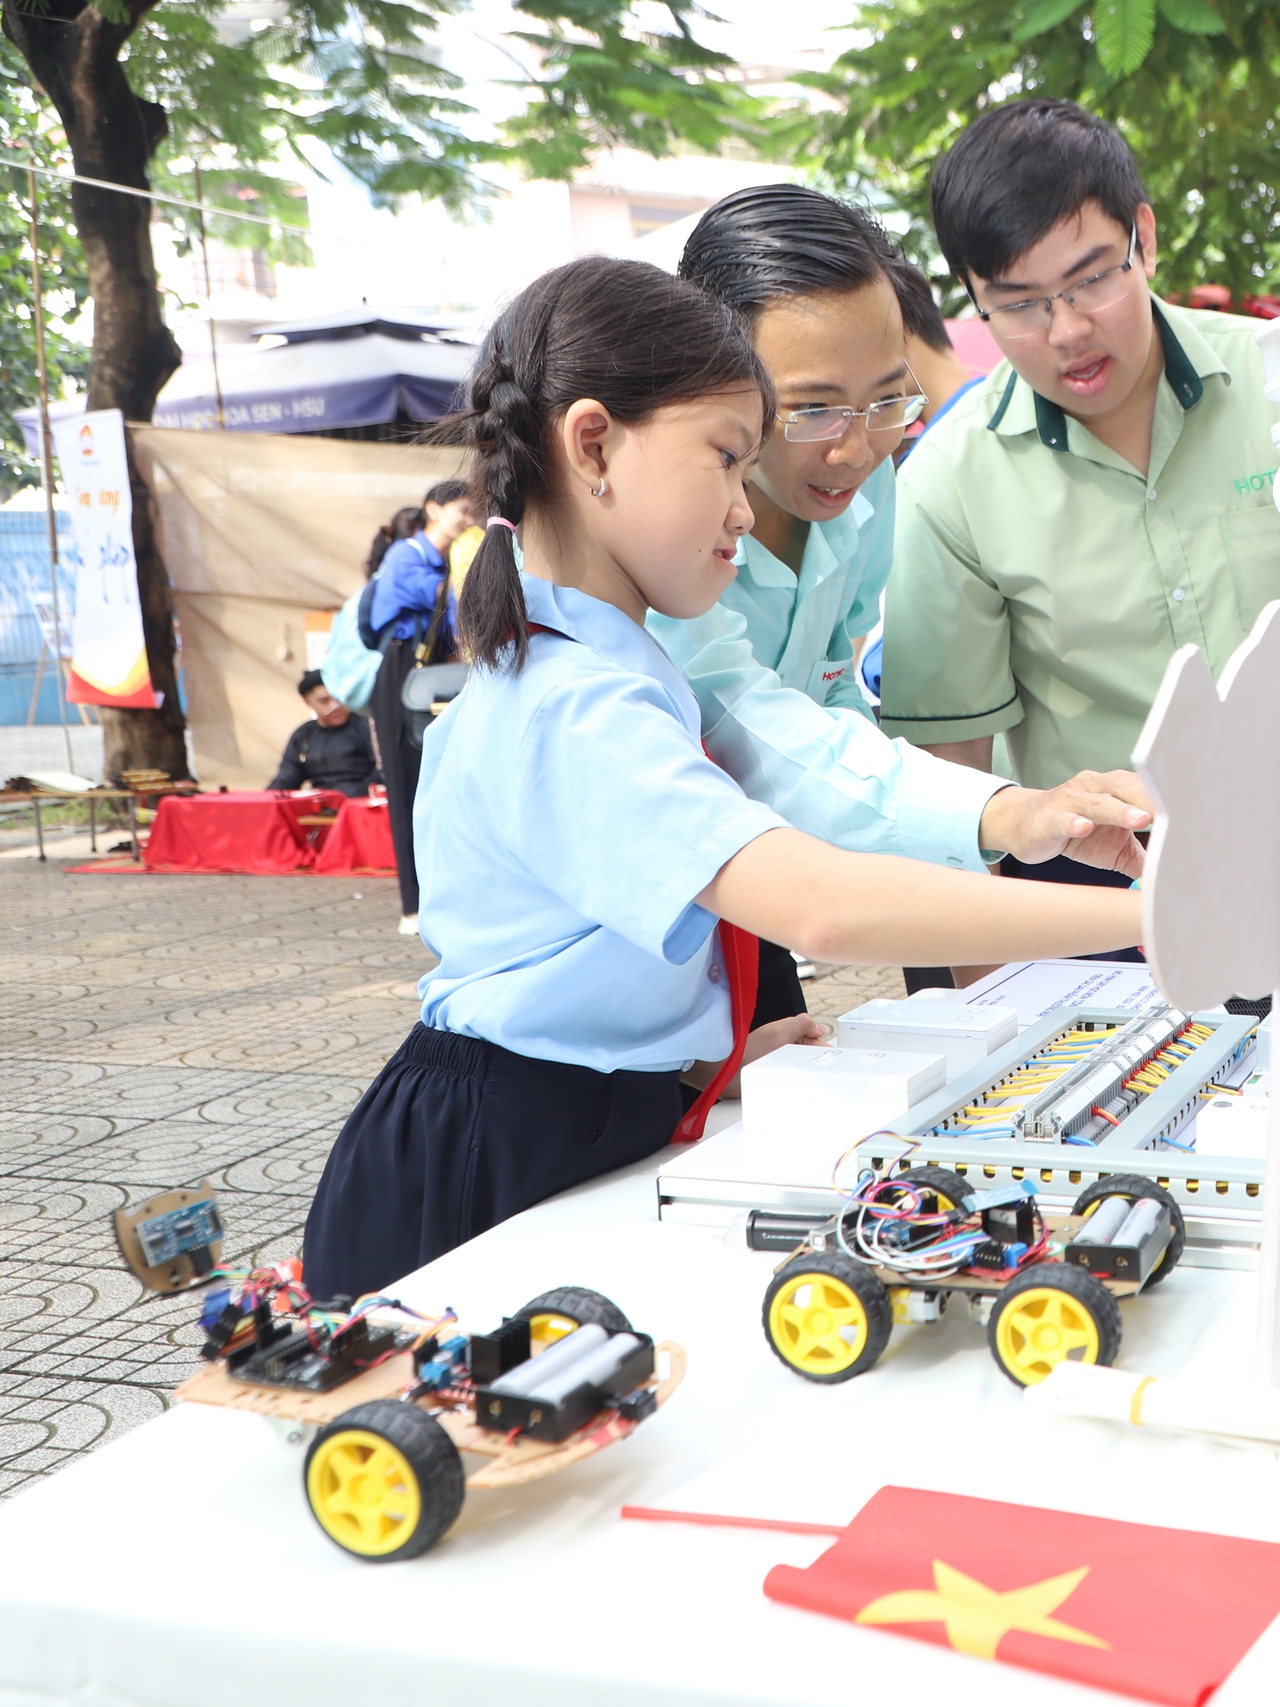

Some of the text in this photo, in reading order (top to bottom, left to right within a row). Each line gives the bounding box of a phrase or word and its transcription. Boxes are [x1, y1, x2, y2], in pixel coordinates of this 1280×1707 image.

[251, 402, 282, 423] SEN
[292, 397, 325, 419] HSU
[1234, 468, 1278, 496] HOT
